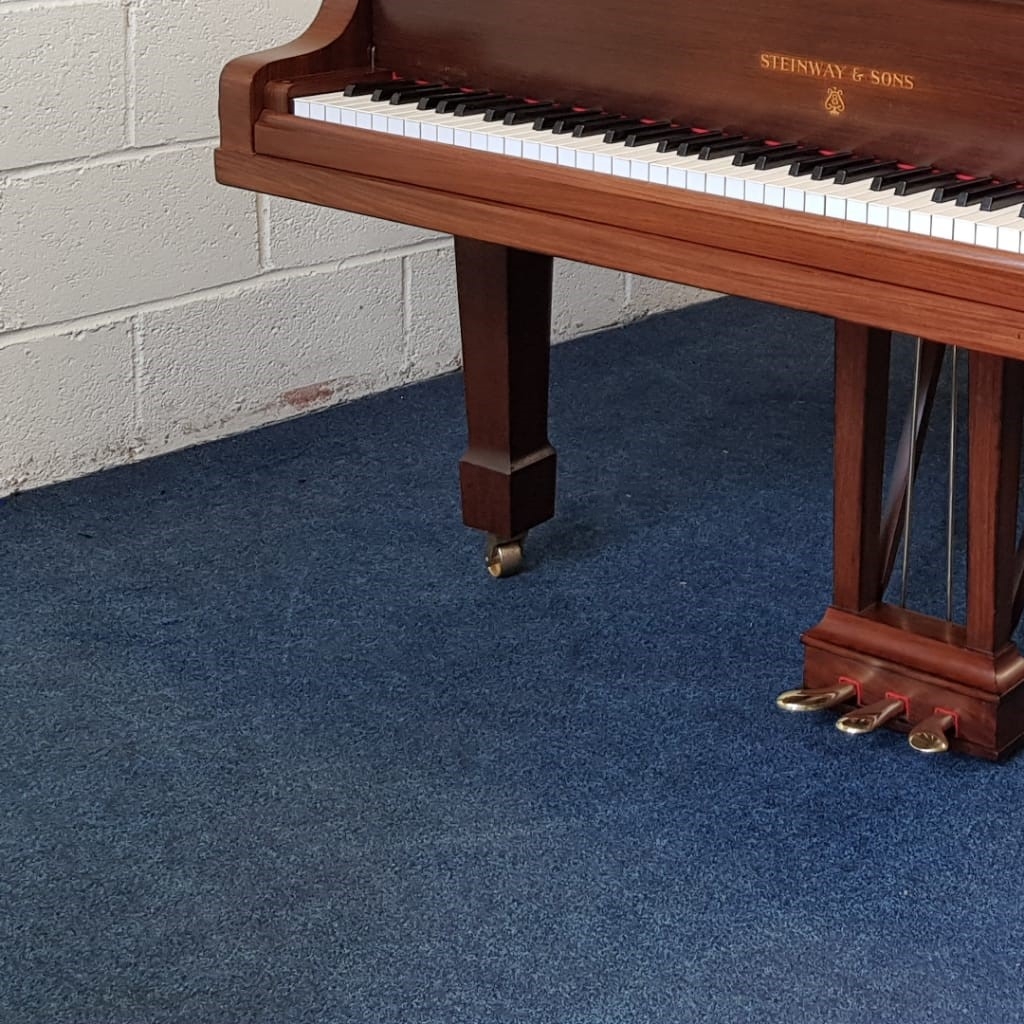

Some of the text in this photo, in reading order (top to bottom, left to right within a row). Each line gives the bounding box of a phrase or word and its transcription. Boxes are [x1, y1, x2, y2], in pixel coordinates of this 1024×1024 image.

[760, 54, 915, 90] STEINWAY & SONS
